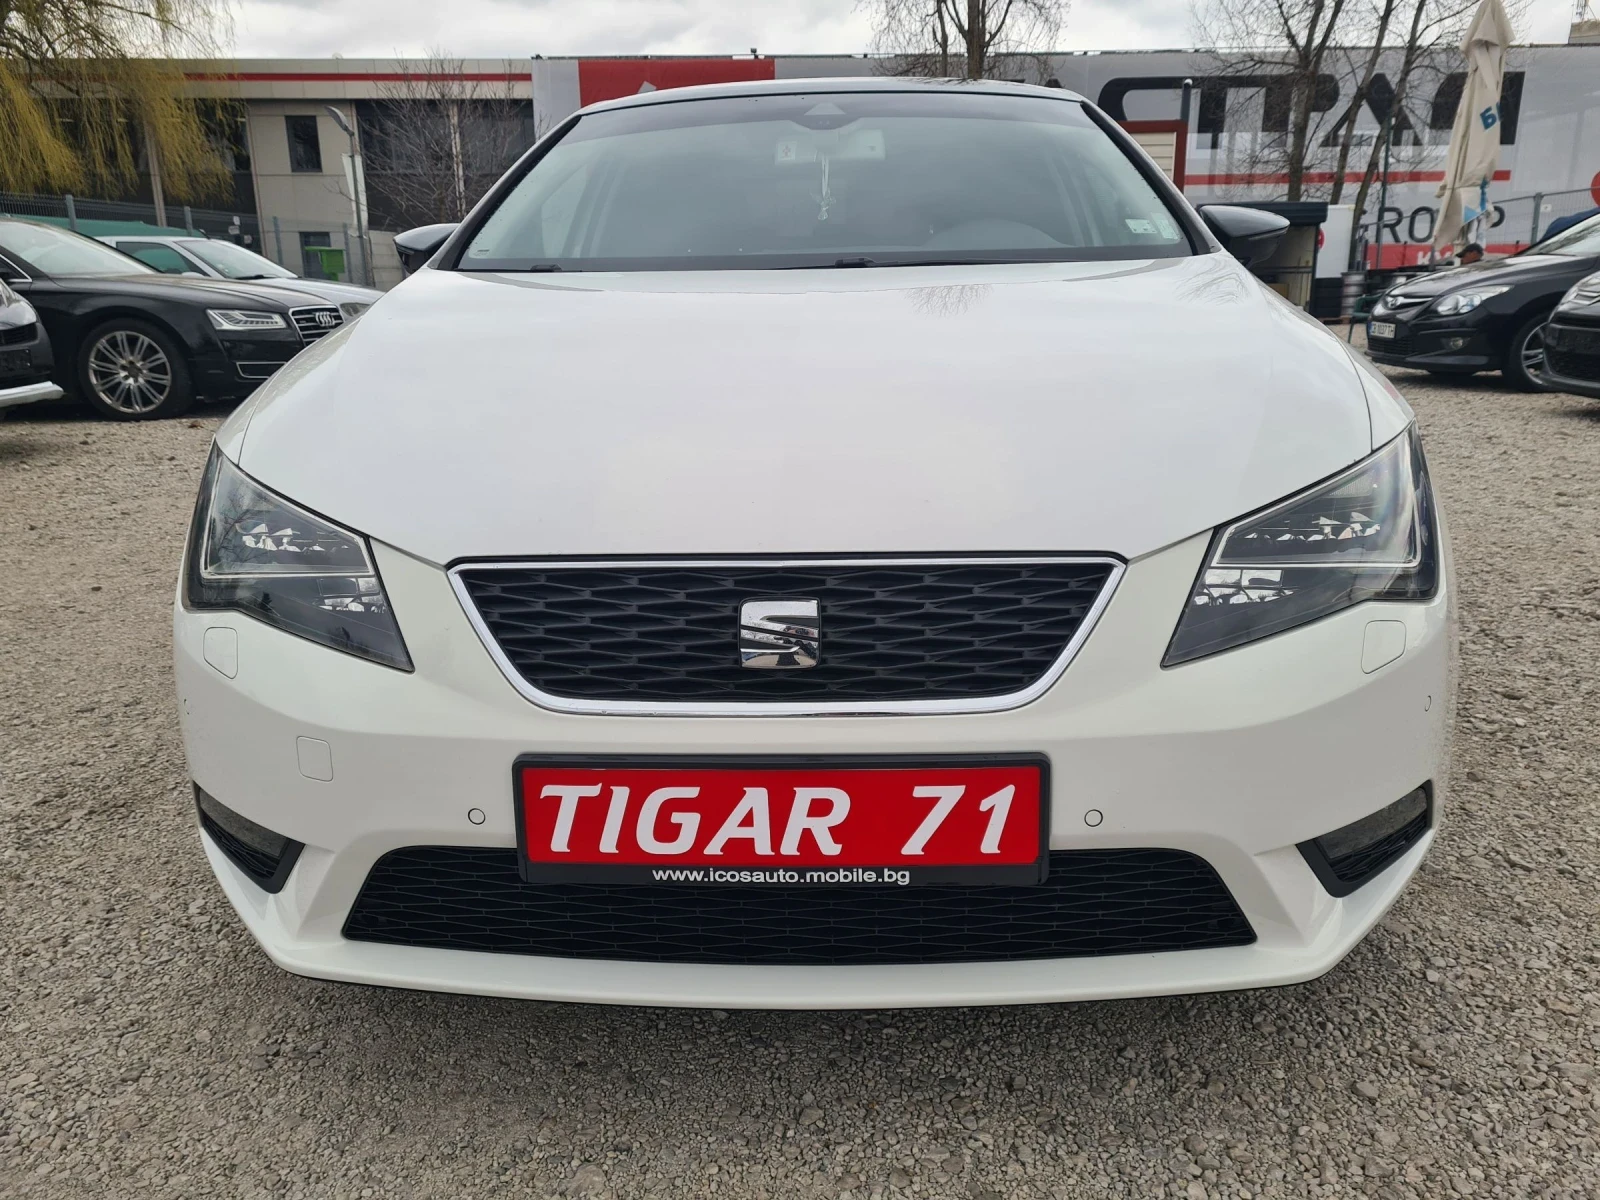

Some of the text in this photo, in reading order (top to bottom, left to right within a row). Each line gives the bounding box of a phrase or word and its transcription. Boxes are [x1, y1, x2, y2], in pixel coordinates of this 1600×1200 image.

[539, 782, 1016, 856] TIGAR 71
[651, 867, 911, 886] www.icosauto.mobile.bg
